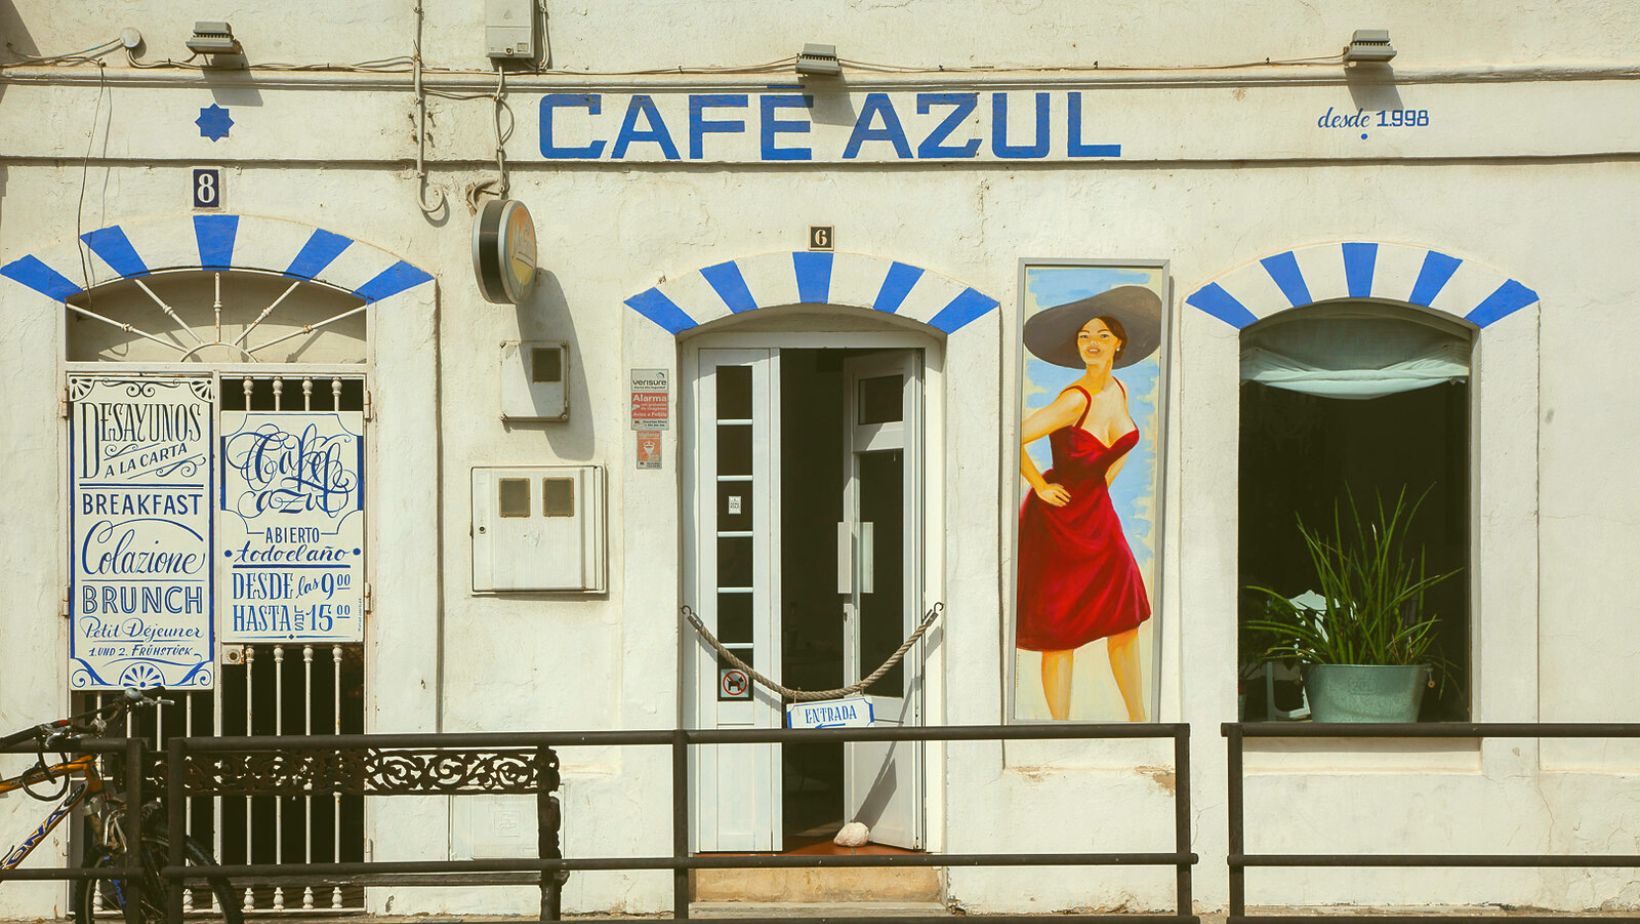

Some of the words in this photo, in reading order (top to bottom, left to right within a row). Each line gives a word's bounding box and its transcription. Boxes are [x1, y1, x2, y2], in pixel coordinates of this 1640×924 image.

[842, 92, 1122, 159] AZUL
[1317, 106, 1370, 128] desde
[1376, 109, 1429, 127] 1.998
[197, 173, 215, 203] 8
[815, 229, 827, 246] 6
[633, 394, 667, 402] Alarma
[79, 402, 201, 479] DESAYUNOS
[104, 465, 115, 478] A
[119, 461, 137, 475] LA
[140, 443, 187, 467] CARTA
[82, 493, 203, 515] BREAKFAST
[82, 519, 206, 574] Colazione
[265, 527, 320, 544] ABIERTO
[306, 546, 350, 562] año
[82, 585, 203, 614] BRUNCH
[232, 572, 293, 600] DESDE
[296, 575, 319, 599] las
[80, 615, 120, 638] Petit
[232, 604, 291, 632] HASTA
[805, 705, 857, 724] ENTRADA
[0, 810, 67, 870] ONA
